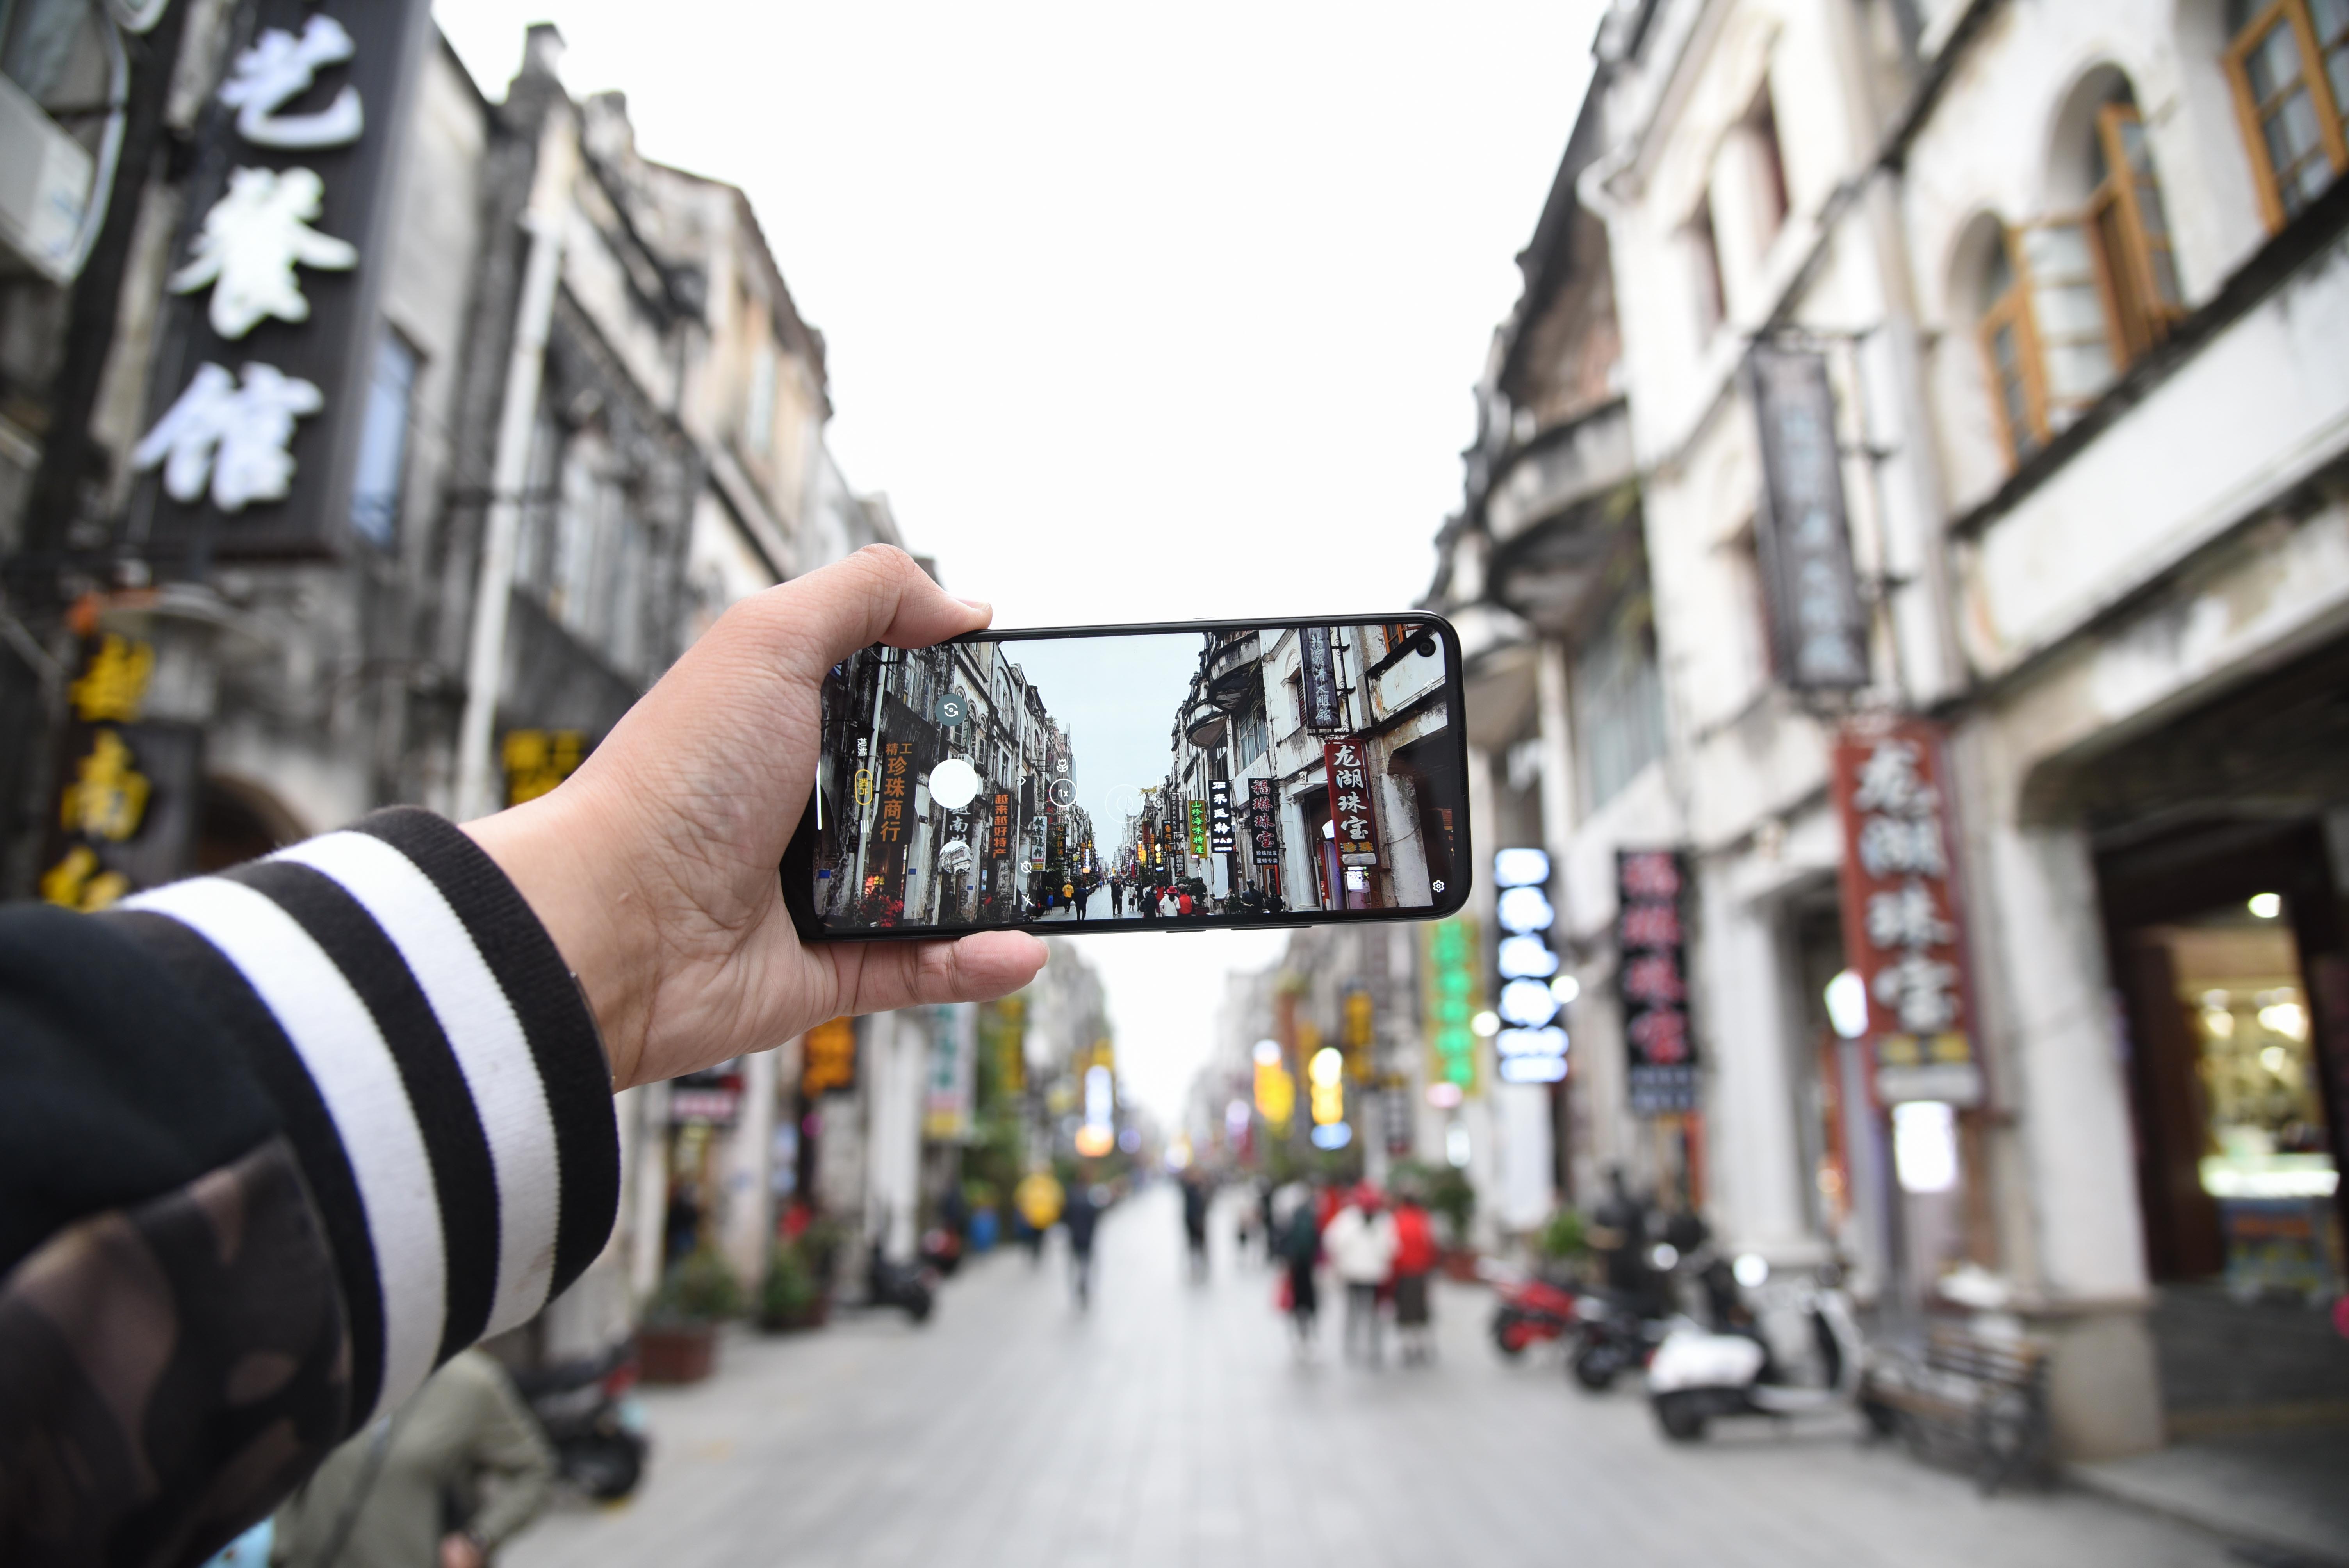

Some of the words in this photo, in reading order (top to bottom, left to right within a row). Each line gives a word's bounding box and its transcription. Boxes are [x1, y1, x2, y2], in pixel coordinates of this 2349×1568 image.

[857, 738, 867, 756] 视频
[886, 743, 912, 755] 精工
[859, 778, 868, 796] 照片
[880, 756, 907, 842] 珍珠商行
[1212, 782, 1230, 834] 石来运转
[1333, 745, 1369, 840] 龙湖珠宝
[993, 794, 1008, 859] 越来越好特产
[1251, 780, 1275, 848] 福琳珠宝
[1340, 841, 1374, 852] 珍珠
